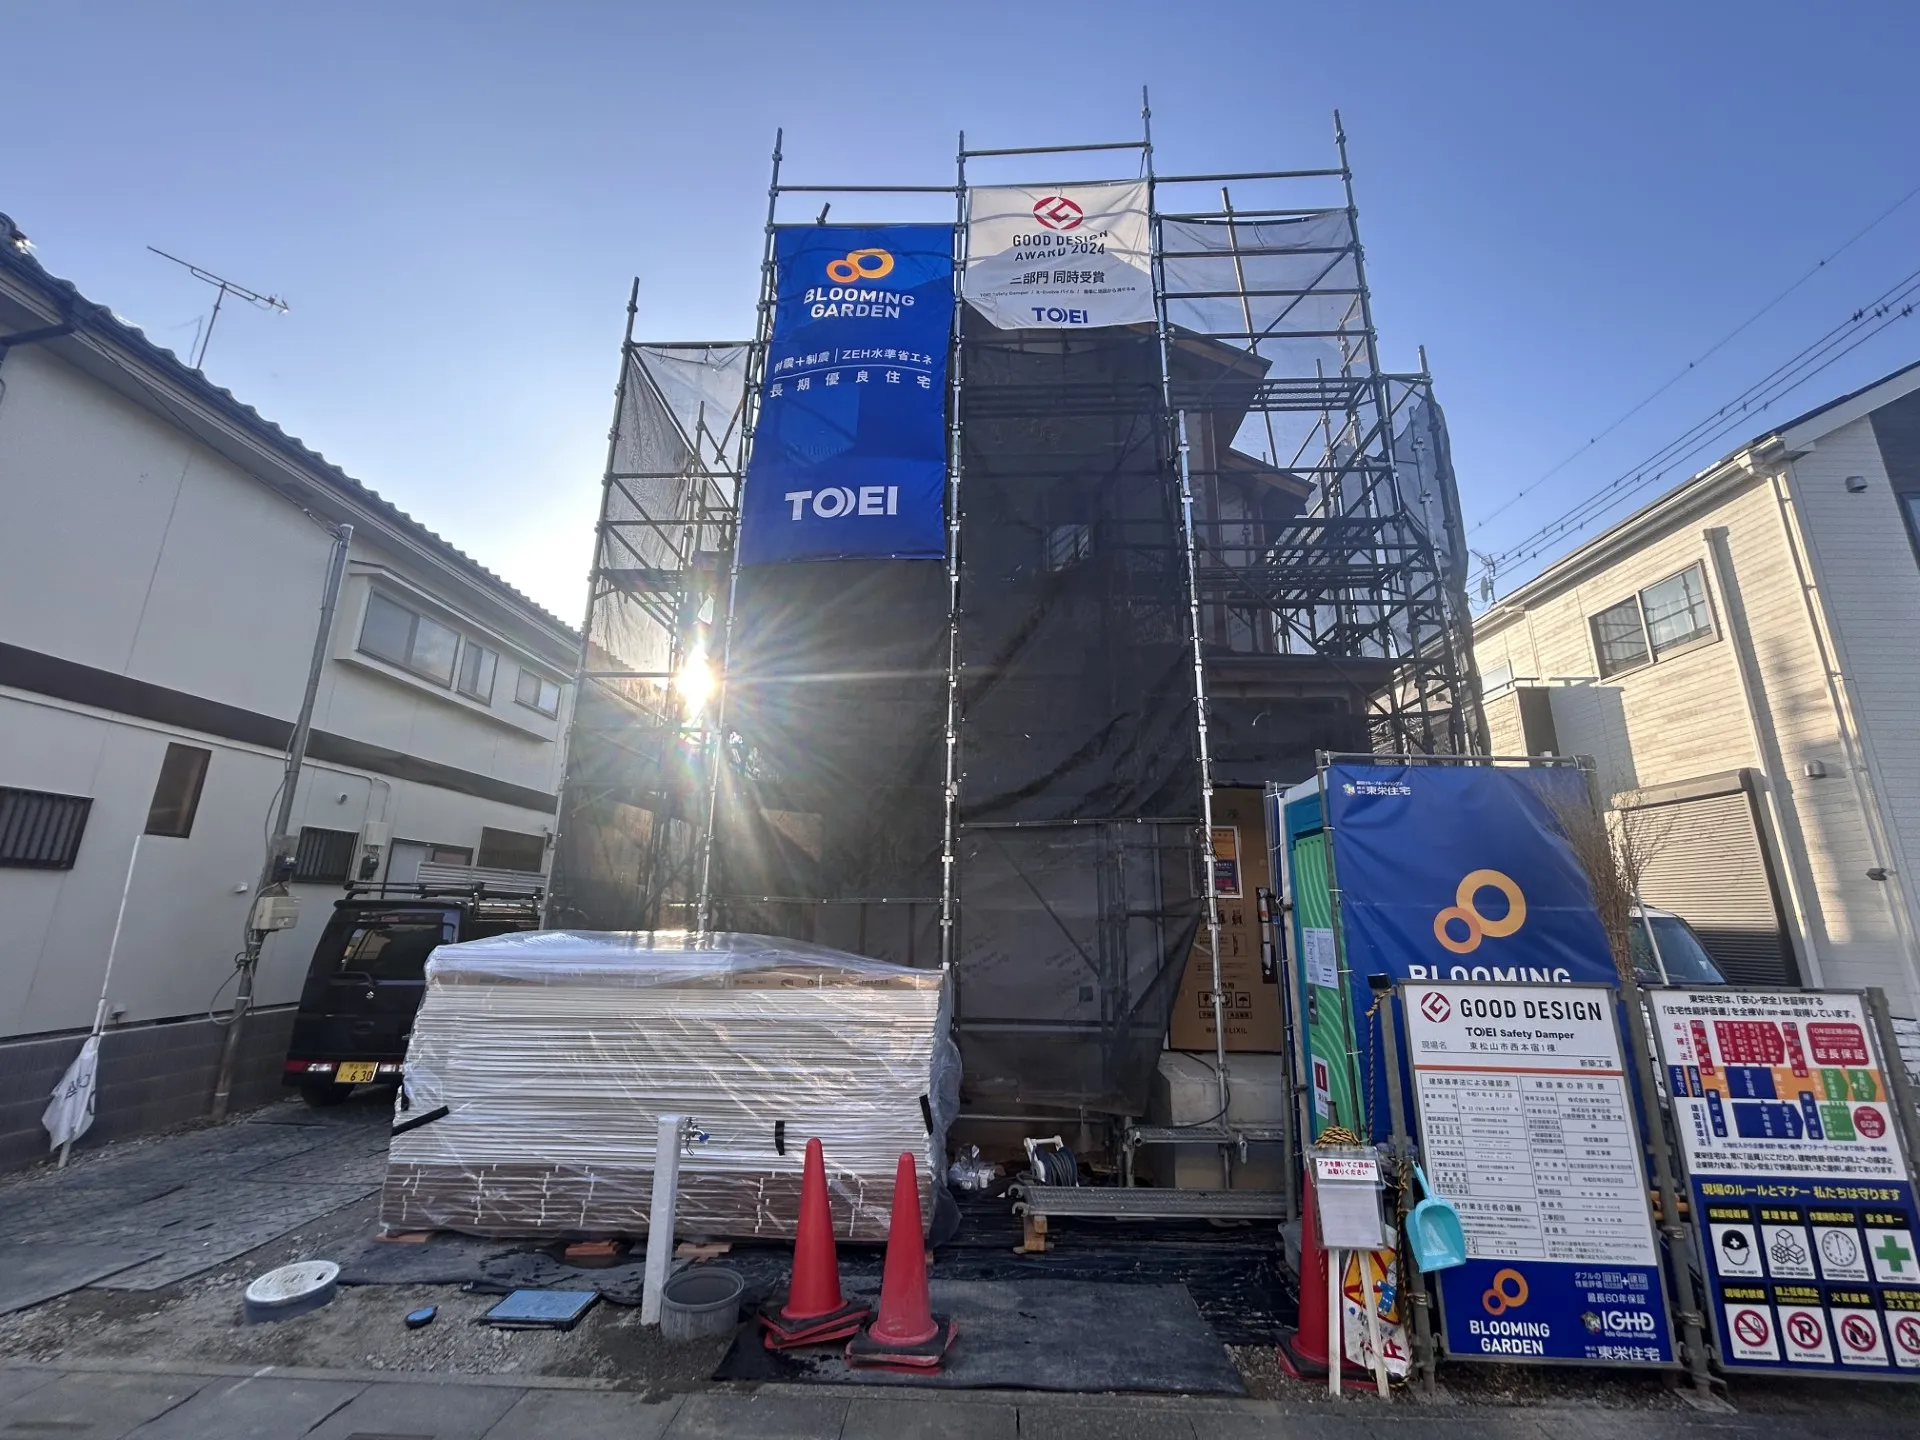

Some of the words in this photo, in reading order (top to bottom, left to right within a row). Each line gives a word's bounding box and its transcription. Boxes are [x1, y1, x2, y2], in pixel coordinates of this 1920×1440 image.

[1013, 234, 1051, 247] GOOD
[1056, 230, 1108, 246] DESIGN
[1014, 247, 1067, 262] AWARD
[1071, 242, 1105, 255] 2024
[1009, 271, 1049, 285] 二部門
[1053, 271, 1106, 285] 同時受賞
[803, 287, 915, 306] BLOOMING
[810, 303, 900, 319] GARDEN
[842, 348, 932, 366] ZEH水準省エネ
[769, 370, 931, 398] 長期優良住宅
[1366, 786, 1411, 796] 東栄住宅
[1460, 998, 1517, 1018] GOOD
[1524, 1000, 1602, 1021] DESIGN
[1500, 1029, 1532, 1040] Safety
[1535, 1030, 1575, 1041] Damper
[1421, 1040, 1447, 1050] 現場名
[1469, 1041, 1556, 1053] 東松山市西本宿1棟
[1815, 1048, 1866, 1060] 延長保証
[1579, 1058, 1613, 1068] 新築工事
[1428, 1077, 1511, 1087] 建築基準法による確認済
[1327, 1168, 1369, 1176] お取りください
[1701, 1183, 1810, 1197] 現場のルールとマナー
[1812, 1186, 1901, 1201] 私たちは守ります
[1575, 1271, 1601, 1280] ダブルの
[1587, 1293, 1646, 1305] 最長60年保証
[1469, 1320, 1550, 1337] BLOOMING
[1481, 1338, 1544, 1355] GARDEN
[1598, 1346, 1660, 1361] 東栄住宅
